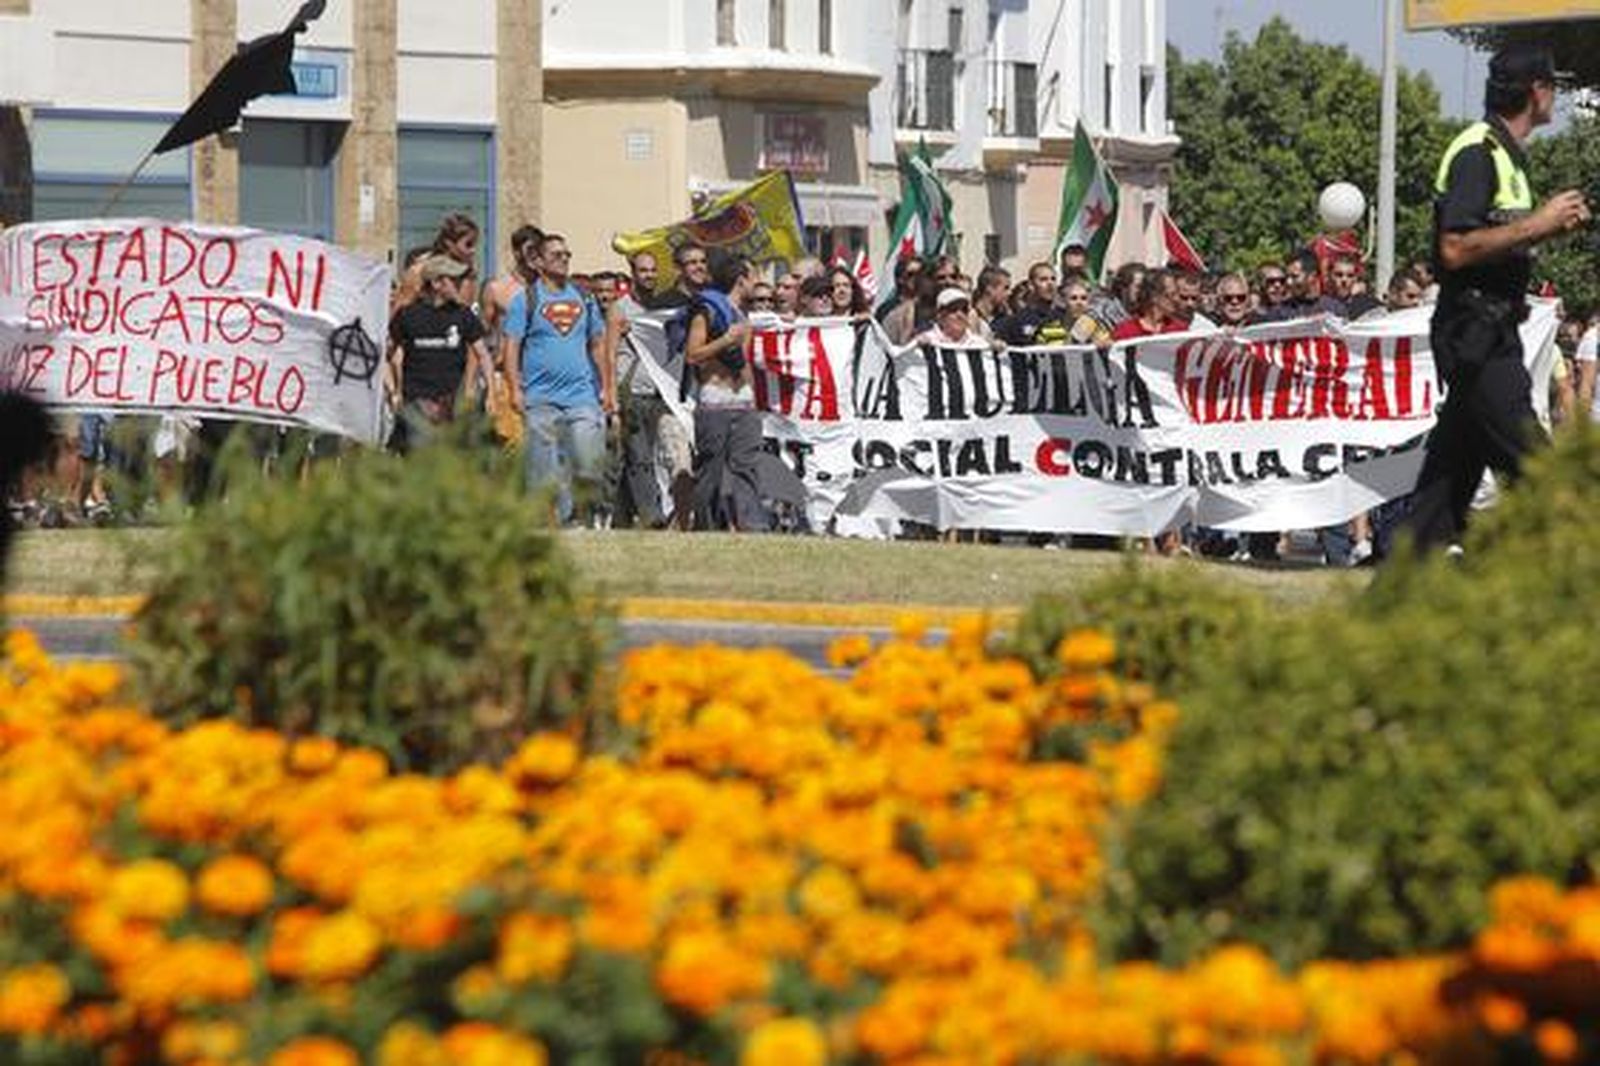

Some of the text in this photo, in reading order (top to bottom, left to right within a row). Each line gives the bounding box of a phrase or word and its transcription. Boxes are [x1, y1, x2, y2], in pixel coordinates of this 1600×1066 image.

[33, 226, 237, 291] ESTADO
[267, 250, 324, 311] NI
[26, 286, 285, 345] SINDICATOS
[65, 345, 134, 400] DEL
[149, 350, 305, 414] PUEBLO
[1173, 336, 1430, 424] GENERAL
